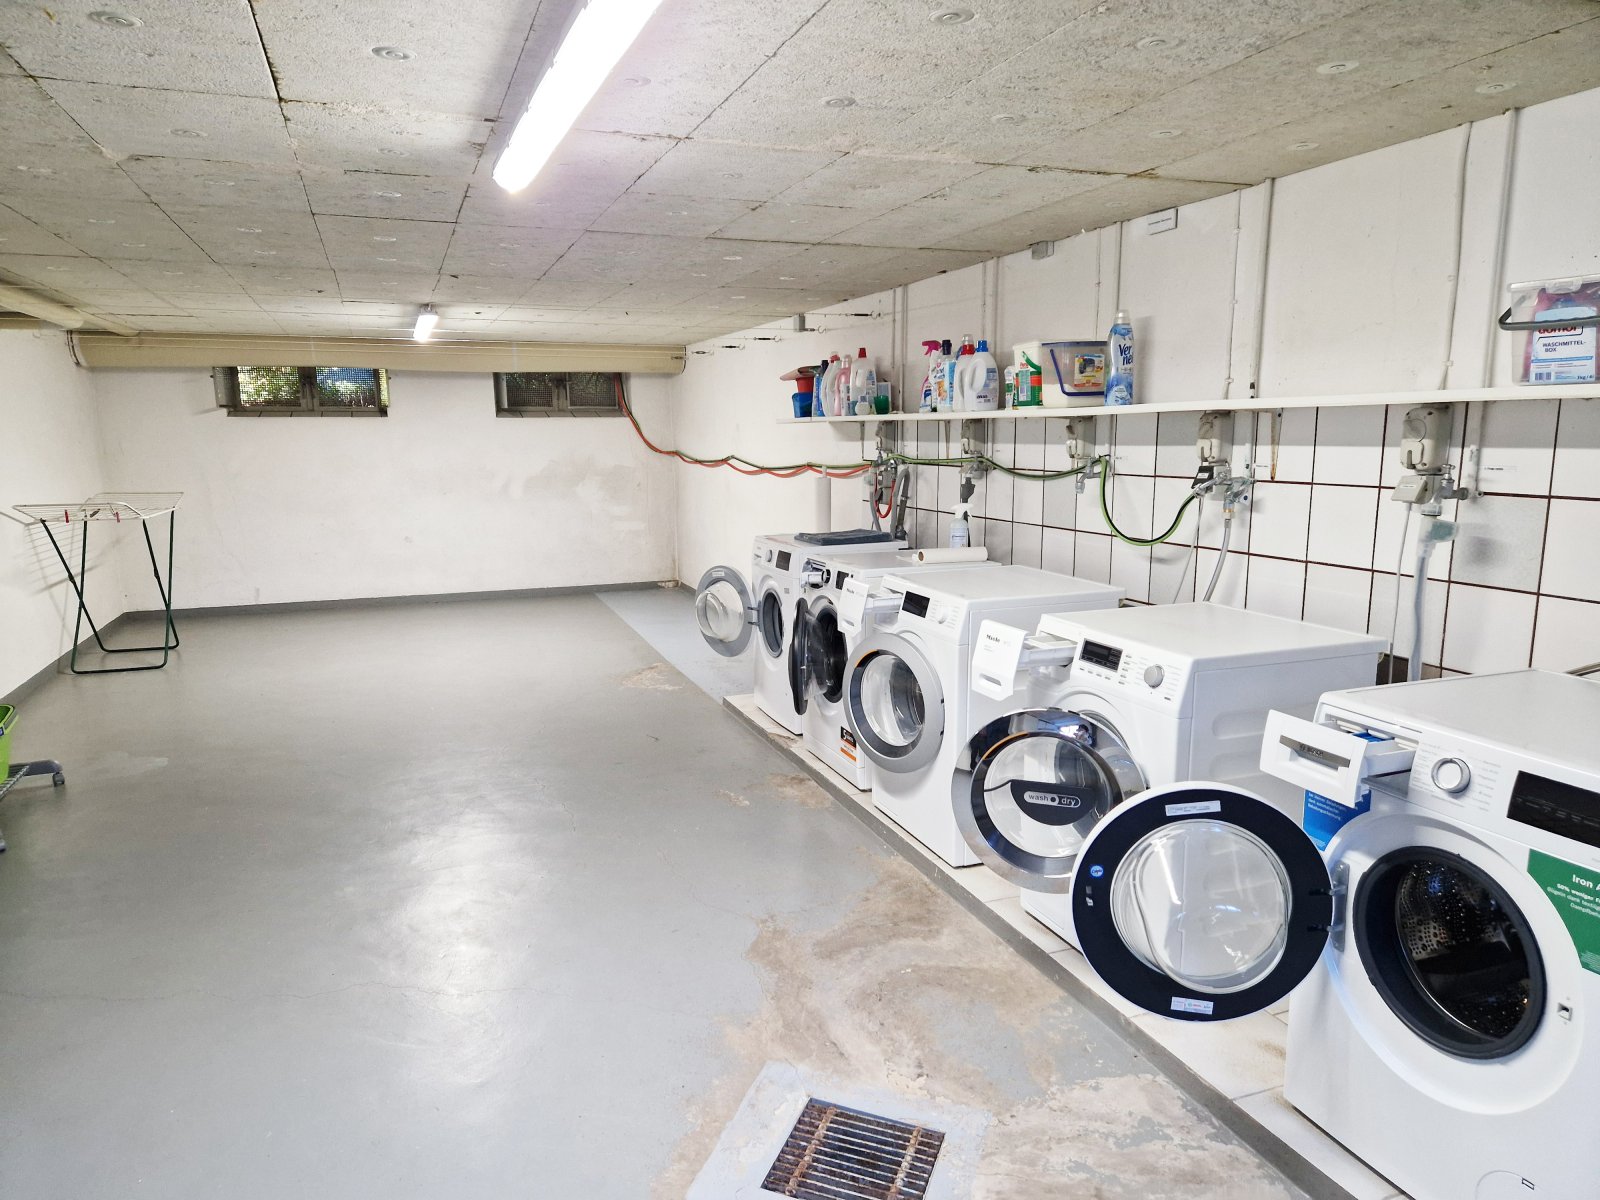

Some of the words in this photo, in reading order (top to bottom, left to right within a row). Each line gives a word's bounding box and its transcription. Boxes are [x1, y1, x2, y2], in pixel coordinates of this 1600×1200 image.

[1119, 344, 1132, 356] Ver
[987, 634, 1000, 642] Miele
[1028, 794, 1049, 802] wash
[1061, 797, 1076, 806] dry
[1572, 874, 1593, 889] Iron
